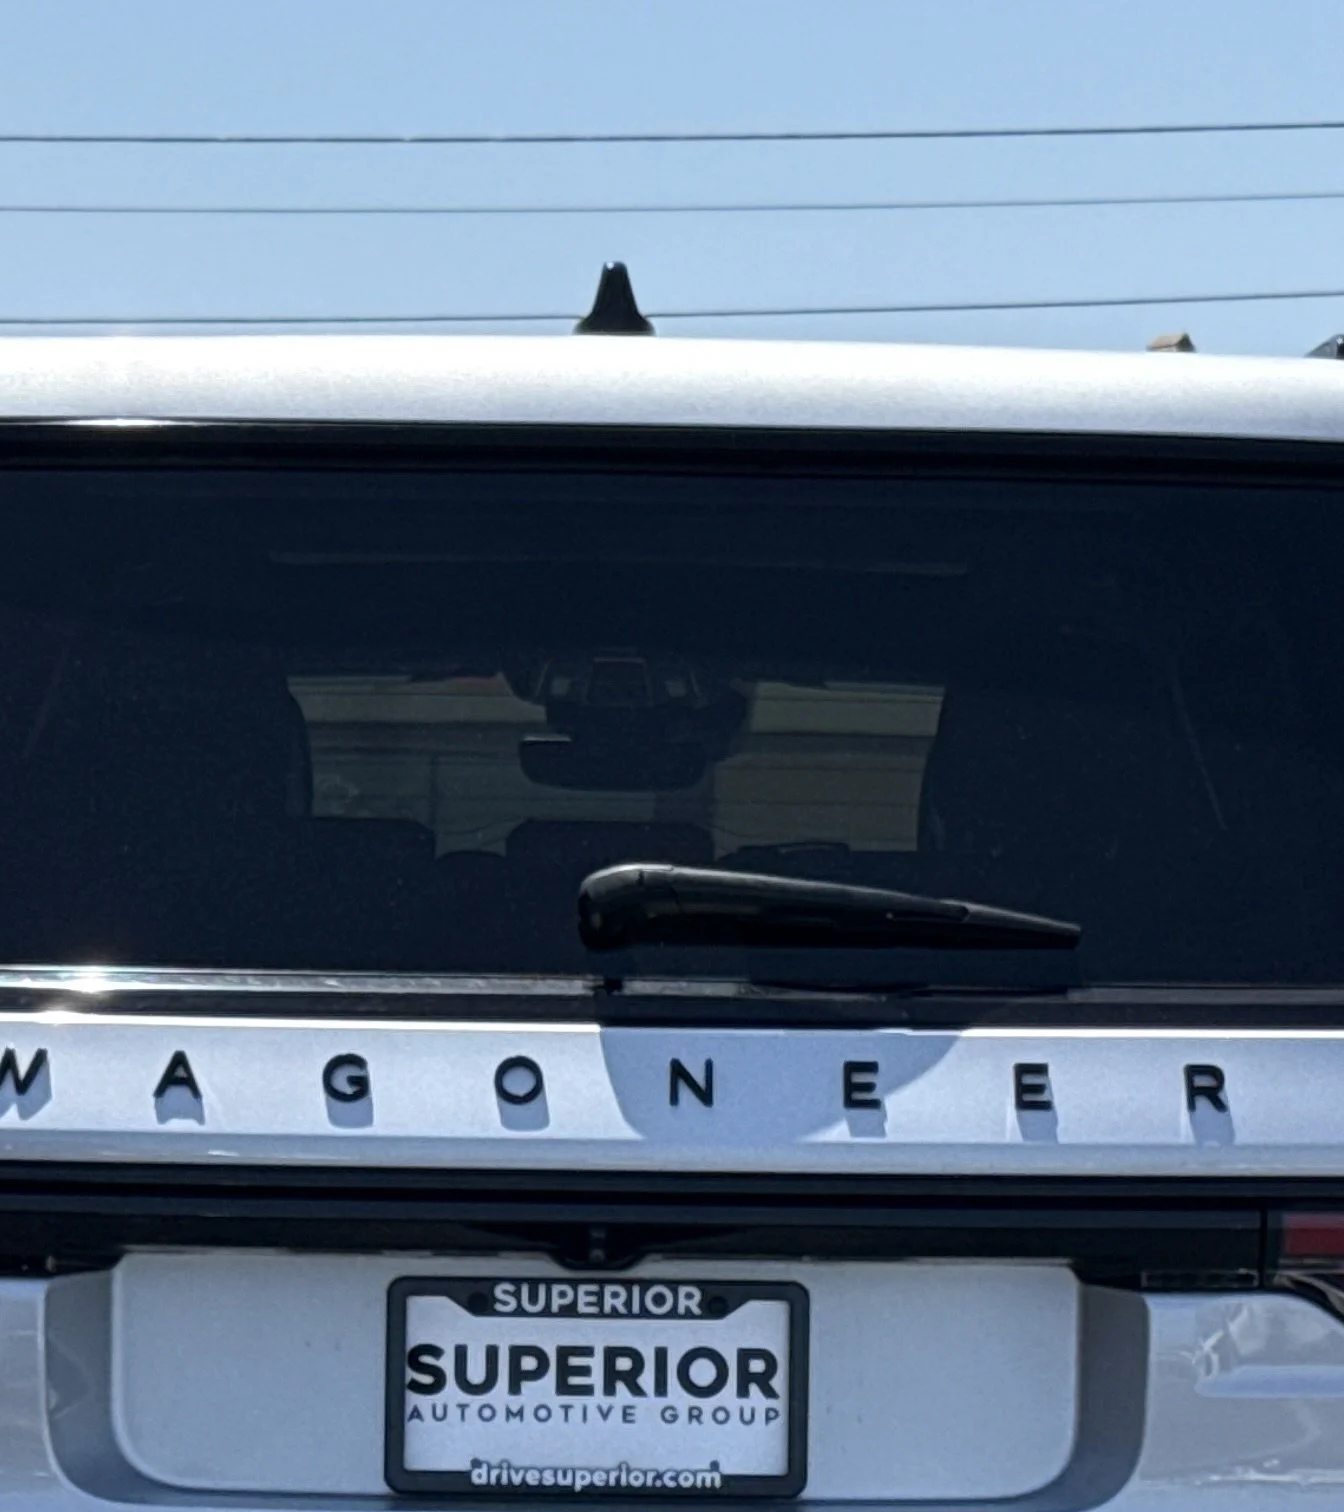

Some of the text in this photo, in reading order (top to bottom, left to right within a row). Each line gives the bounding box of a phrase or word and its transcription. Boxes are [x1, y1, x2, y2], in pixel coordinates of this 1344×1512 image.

[493, 1282, 703, 1316] SUPERIOR
[406, 1343, 781, 1400] SUPERIOR
[406, 1402, 781, 1426] AUTOMOTIVE GROUP
[470, 1460, 723, 1492] drivesuperior.com
